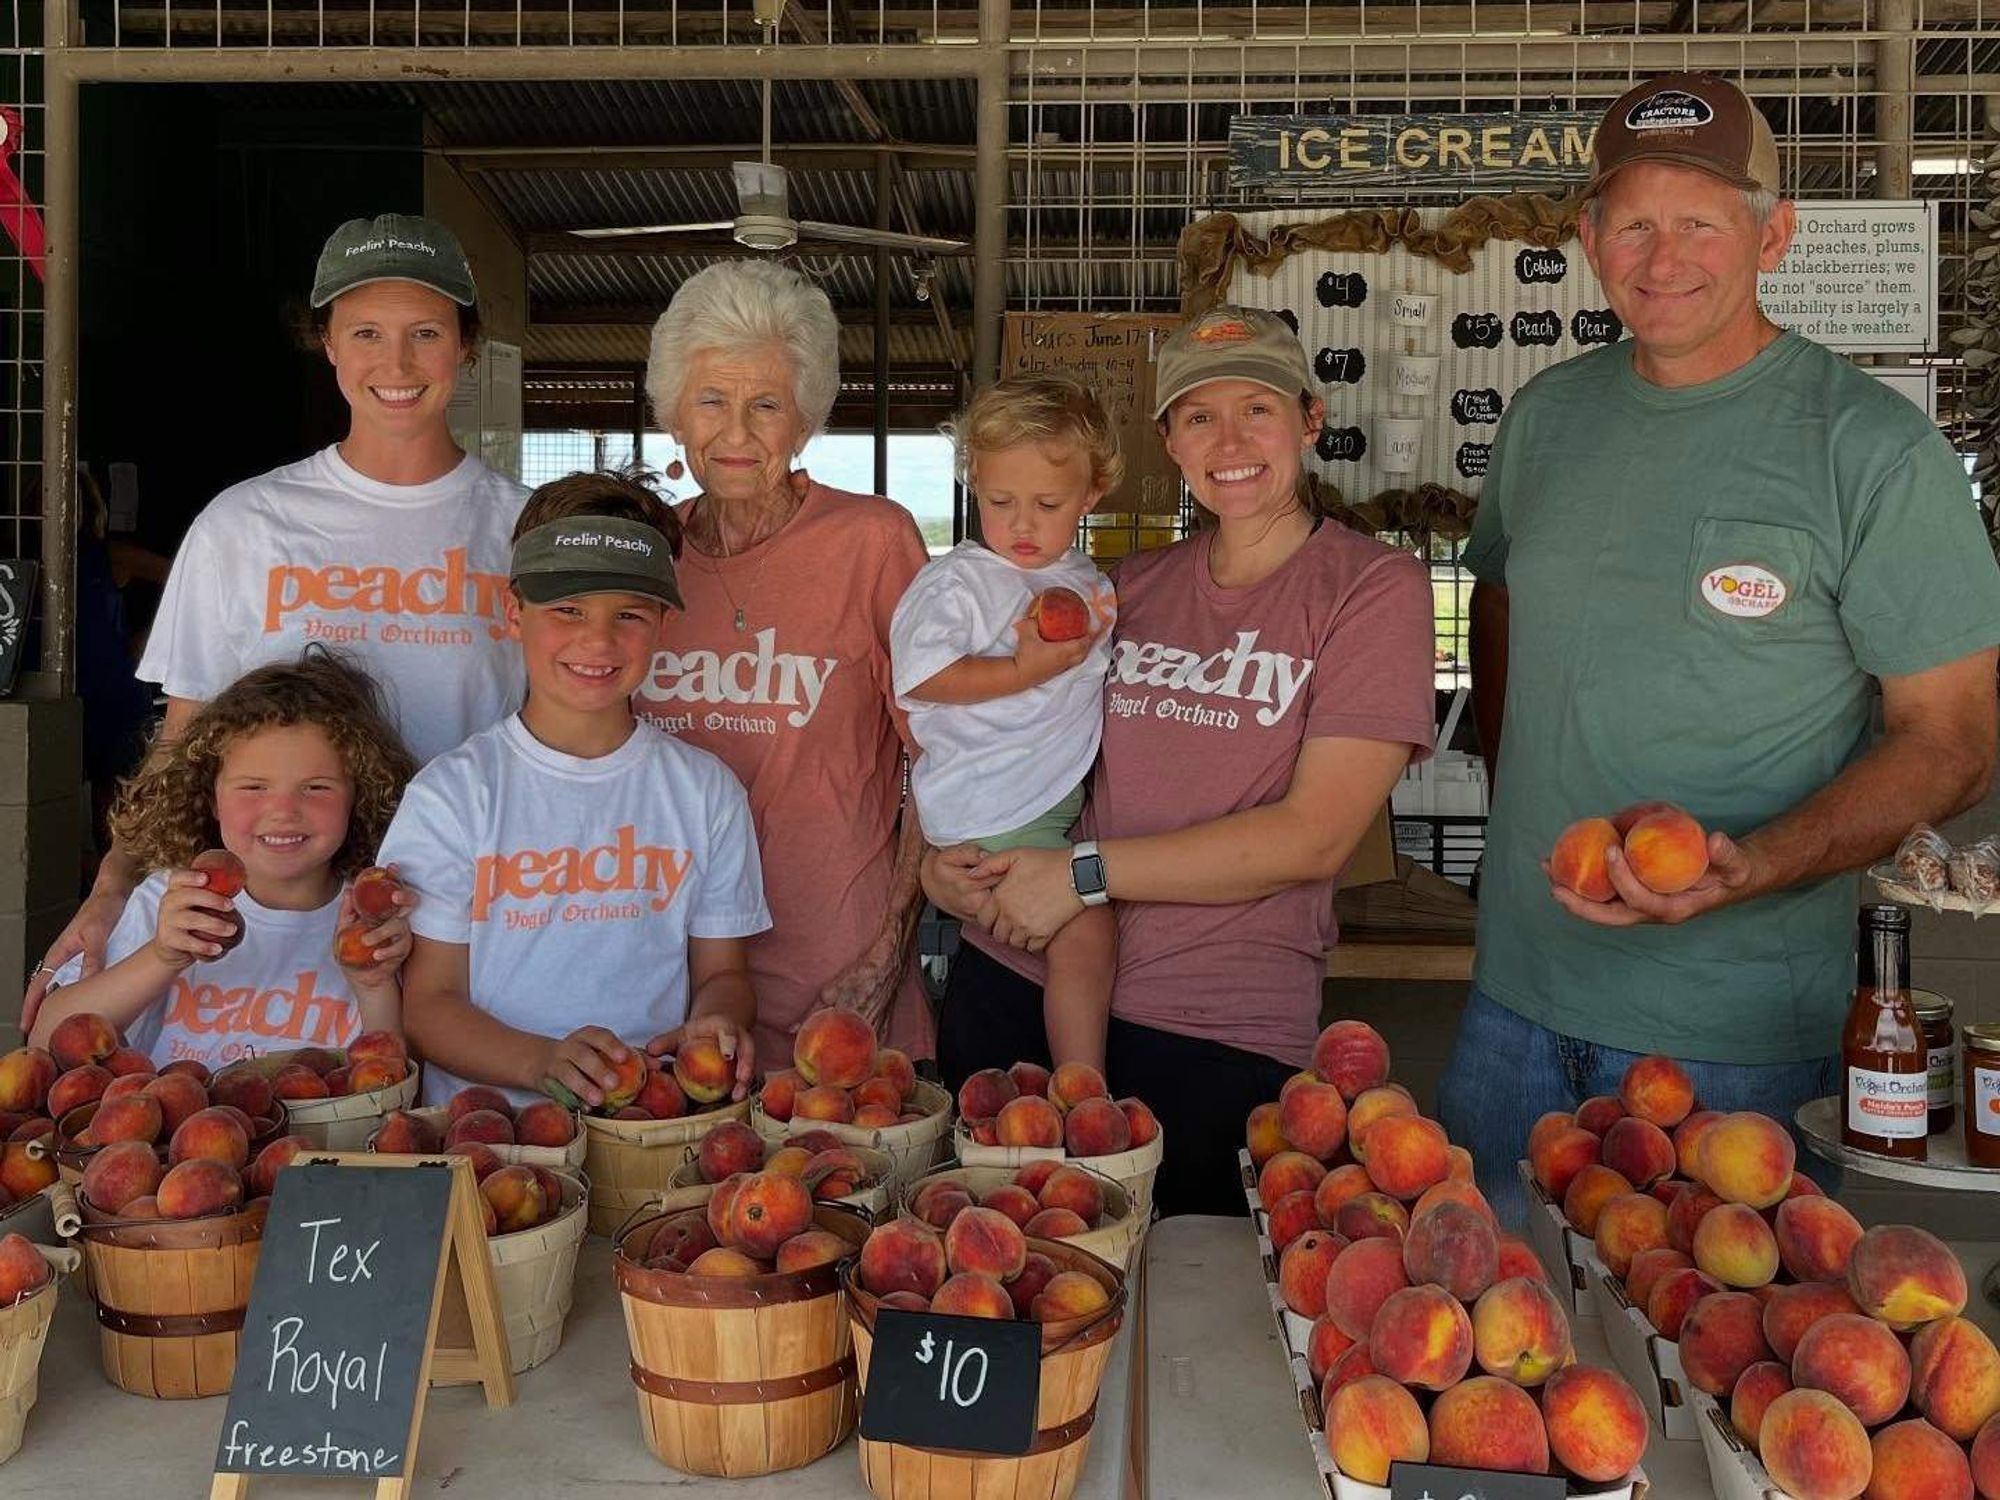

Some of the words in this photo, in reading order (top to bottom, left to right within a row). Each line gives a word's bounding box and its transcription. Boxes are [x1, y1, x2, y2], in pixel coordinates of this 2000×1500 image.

[1279, 128, 1371, 170] ICE
[1395, 126, 1598, 168] CREAM
[1807, 219, 1867, 233] Orchard
[1872, 221, 1915, 237] grows
[345, 240, 385, 257] Feelin'
[388, 239, 436, 257] Peachy
[1806, 240, 1870, 257] peaches,
[1875, 239, 1925, 257] plums,
[1523, 256, 1567, 279] Cobbler
[1792, 259, 1891, 274] blackberries;
[1895, 262, 1917, 273] we
[1327, 276, 1350, 301] $4
[1759, 280, 1778, 294] do
[1782, 281, 1805, 294] not
[1809, 280, 1870, 294] "source"
[1875, 280, 1917, 294] them.
[1394, 299, 1426, 319] Small
[1841, 300, 1854, 313] is
[1857, 300, 1910, 318] largely
[1913, 303, 1922, 313] a
[1020, 320, 1077, 350] Hours
[1083, 324, 1124, 348] June
[1517, 316, 1553, 338] Peach
[1579, 316, 1610, 338] Pear
[1806, 318, 1821, 334] of
[1824, 319, 1848, 334] the
[1852, 319, 1914, 334] weather.
[1324, 352, 1349, 381] $7
[1325, 434, 1354, 458] $10
[555, 533, 602, 546] Feelin'
[605, 535, 652, 556] Peachy
[304, 617, 369, 642] Vogel
[380, 622, 474, 646] Orchard
[636, 627, 838, 728] eachy
[704, 711, 777, 735] Orchard
[1109, 692, 1148, 718] Vogel
[1155, 698, 1240, 730] Orchard
[472, 825, 693, 922] peachy
[504, 907, 553, 931] Vogel
[562, 903, 641, 923] Orchard
[1855, 1076, 1886, 1095] Vogel
[300, 1217, 382, 1284] Tex
[267, 1316, 388, 1410] Royal
[915, 1331, 988, 1407] $10
[225, 1420, 399, 1473] freestone
